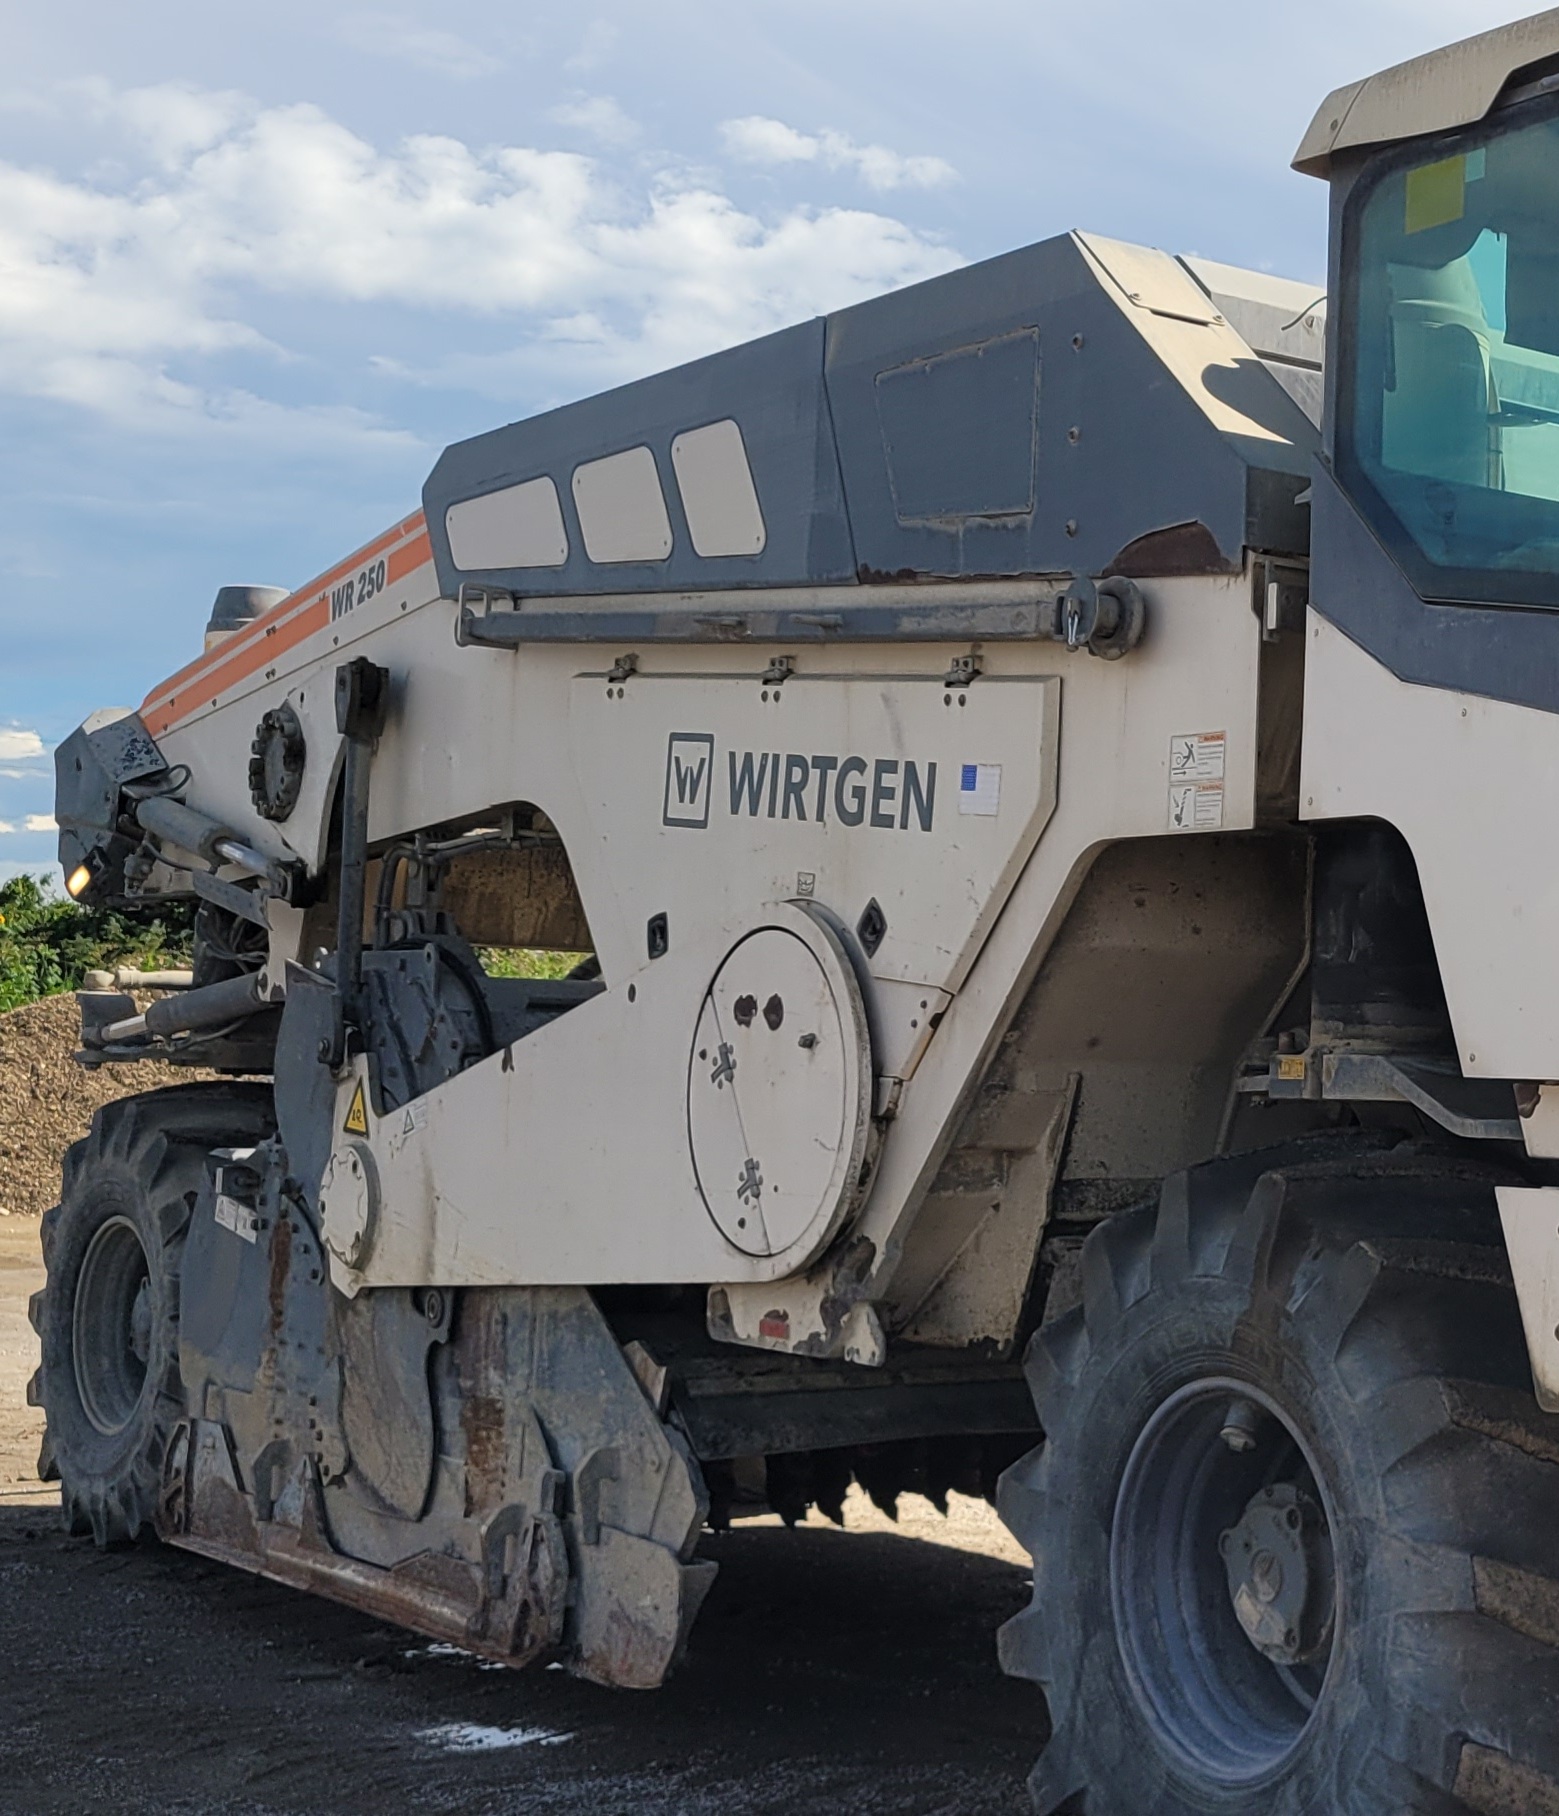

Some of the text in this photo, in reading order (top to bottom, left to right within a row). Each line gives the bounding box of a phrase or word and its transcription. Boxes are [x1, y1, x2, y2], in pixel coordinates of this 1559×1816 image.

[331, 559, 386, 622] WR 250
[728, 750, 938, 832] WIRTGEN
